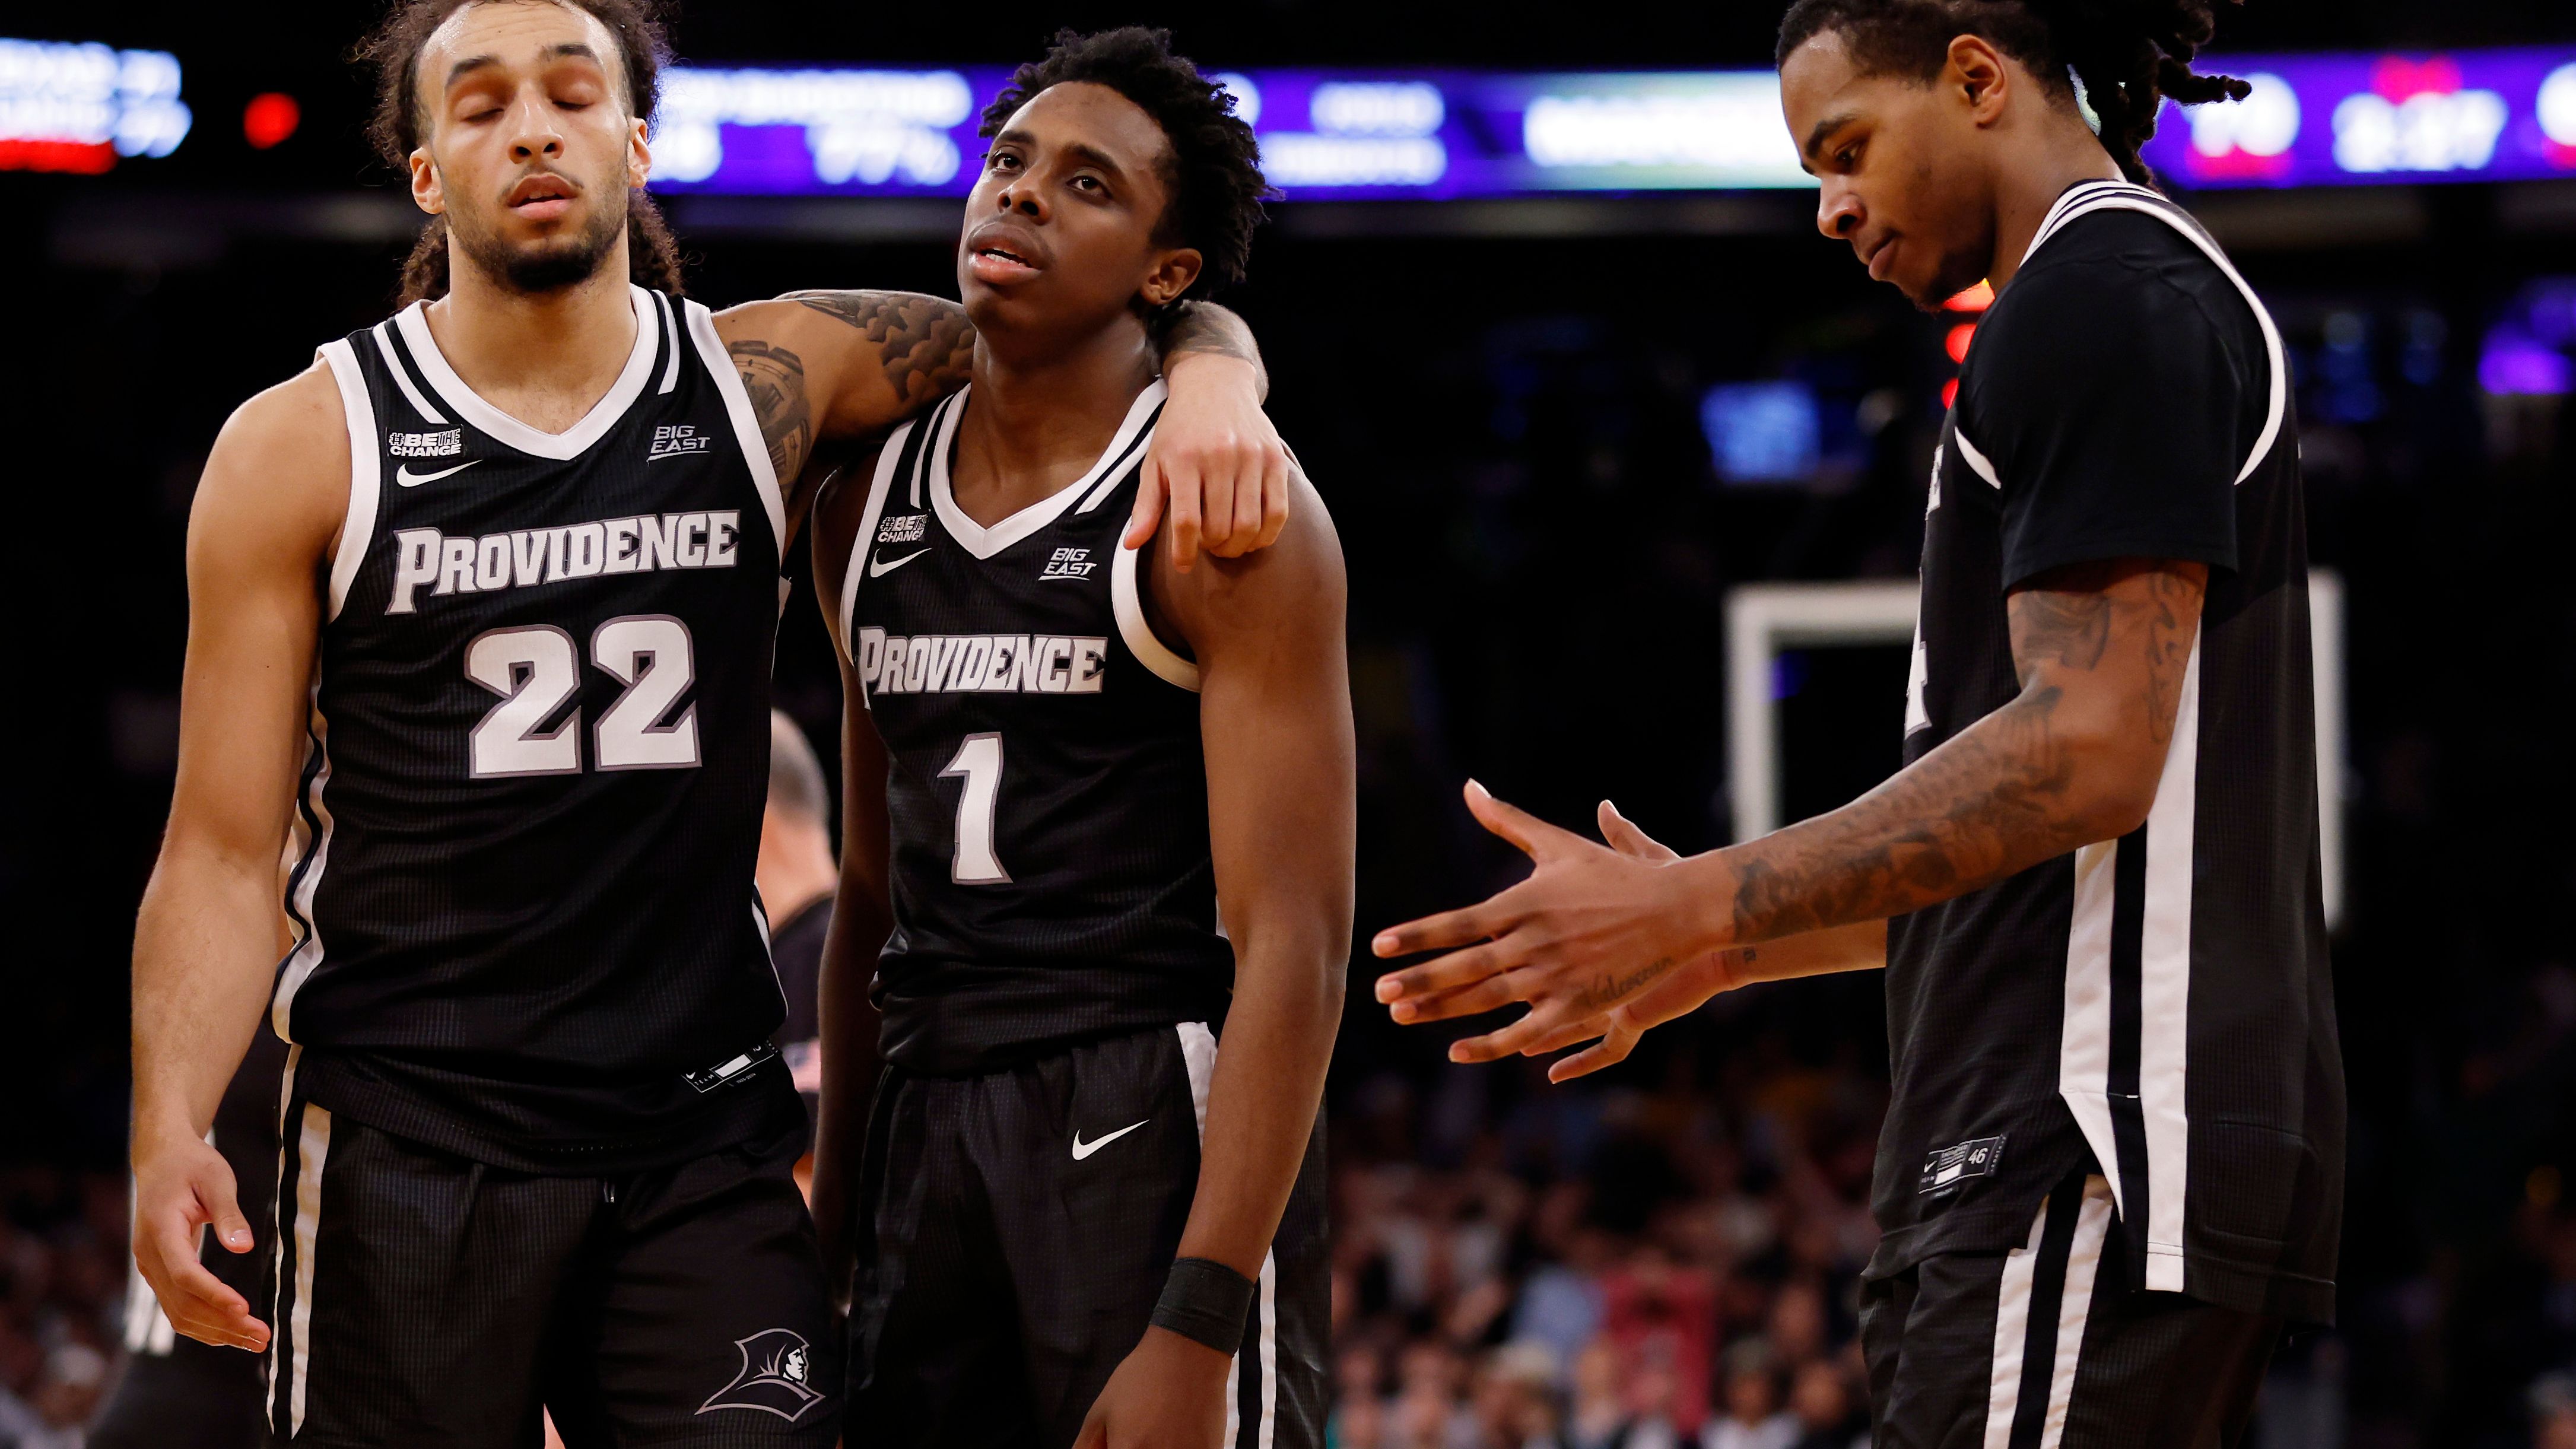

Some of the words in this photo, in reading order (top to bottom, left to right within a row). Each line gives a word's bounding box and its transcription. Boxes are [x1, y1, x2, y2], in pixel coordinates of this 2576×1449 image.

[653, 425, 695, 440] BIG
[390, 443, 462, 457] CHANGE
[650, 437, 710, 453] EAST
[385, 509, 741, 615] PROVIDENCE
[1050, 548, 1091, 562] BIG
[1043, 562, 1097, 576] EAST
[858, 626, 1108, 711] PROVIDENCE
[464, 614, 702, 778] 22
[937, 732, 1014, 885] 1
[1968, 1148, 1989, 1165] 46
